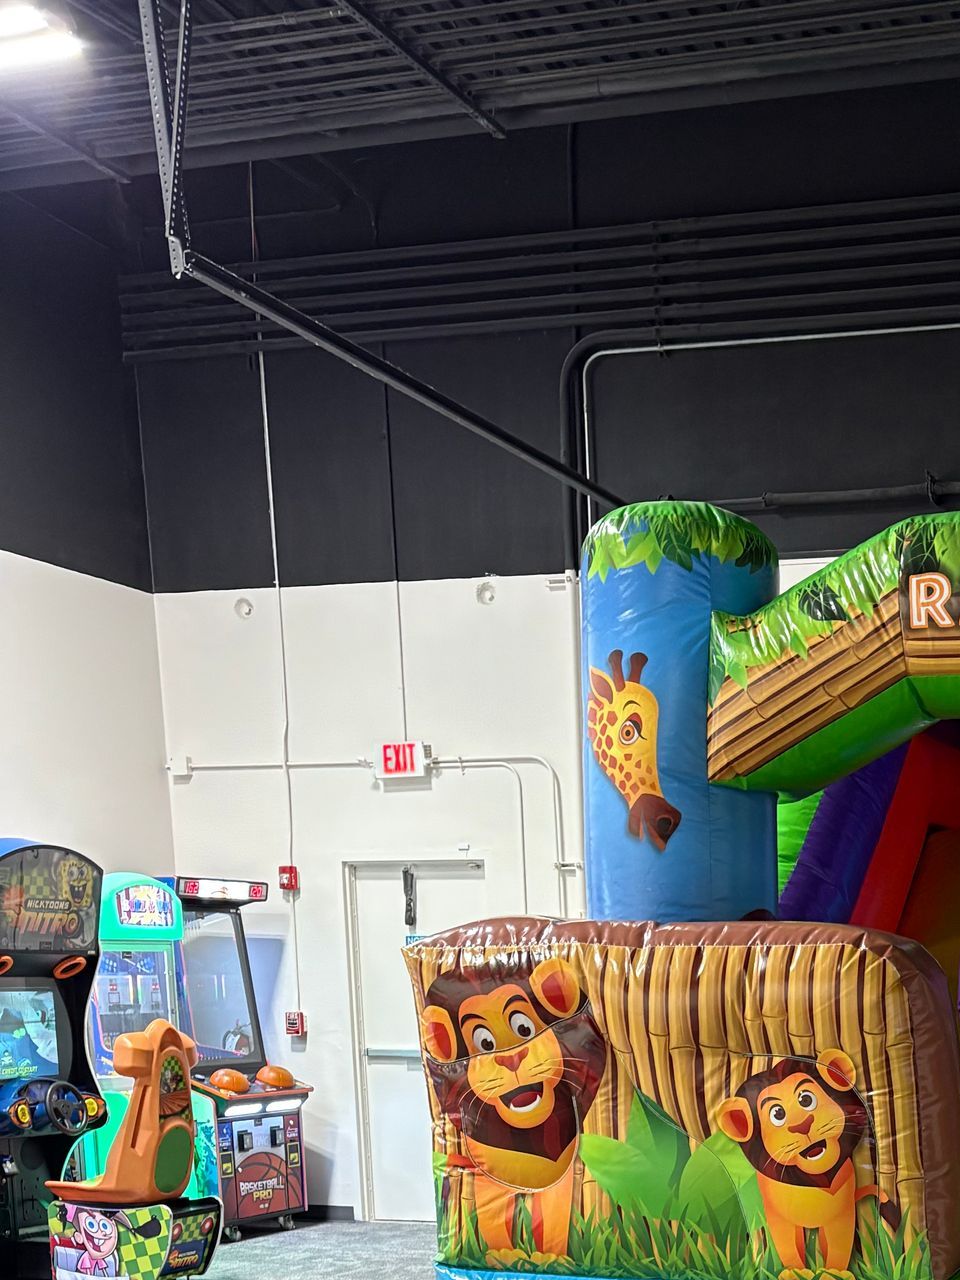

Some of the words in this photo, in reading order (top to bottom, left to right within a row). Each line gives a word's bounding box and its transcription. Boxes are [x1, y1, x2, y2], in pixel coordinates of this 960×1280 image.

[382, 743, 416, 775] EXIT
[27, 900, 70, 910] NICKTOONS
[18, 911, 79, 937] NITRO
[240, 1176, 285, 1197] BASKETBALL
[253, 1189, 273, 1201] PRO
